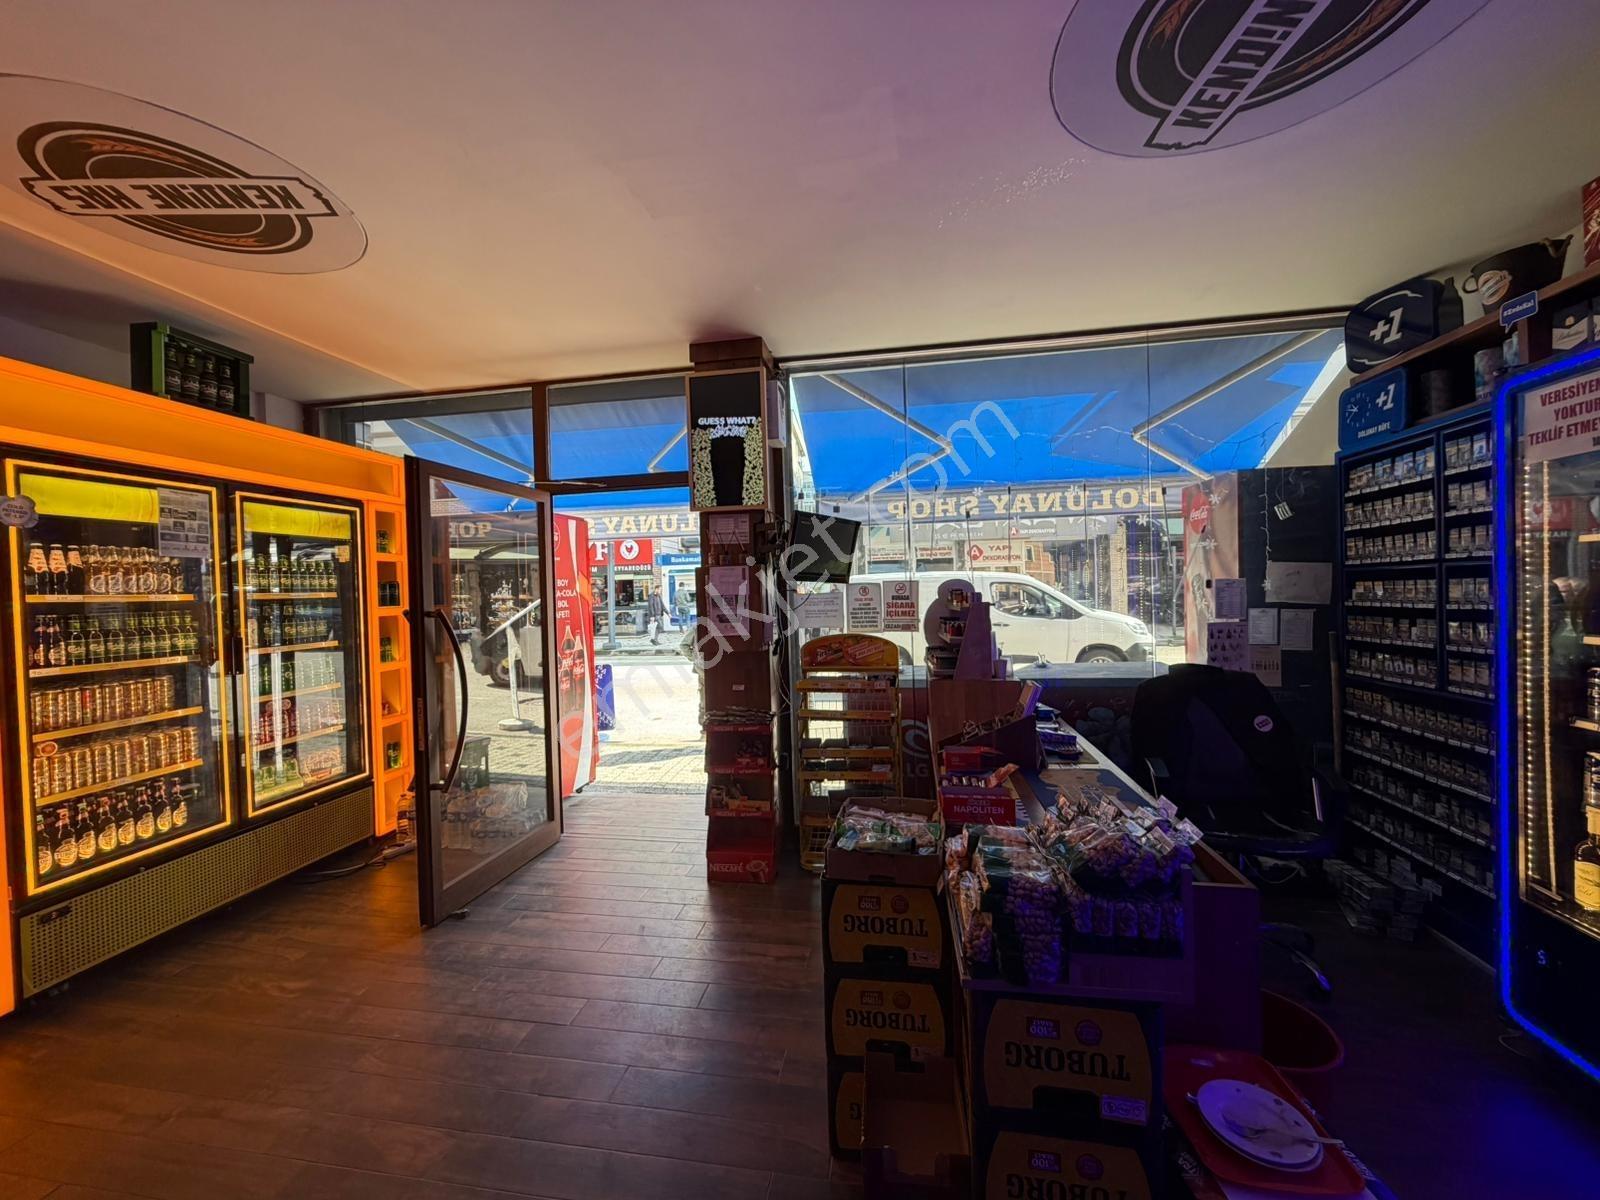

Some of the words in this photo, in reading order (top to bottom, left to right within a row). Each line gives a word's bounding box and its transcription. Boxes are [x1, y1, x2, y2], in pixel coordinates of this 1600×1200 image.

[48, 184, 144, 210] HAS
[1369, 306, 1404, 345] +1
[1375, 382, 1397, 412] +1
[698, 416, 725, 426] GUESS
[725, 415, 757, 425] WHAT?
[1528, 425, 1564, 446] TEKLİF
[556, 589, 577, 598] A-COLA
[886, 601, 915, 609] SİGARA
[886, 609, 915, 618] İÇİLMEZ
[906, 763, 929, 777] LG
[709, 861, 745, 873] NESCAFÉ
[843, 914, 929, 938] TUBORG
[845, 1008, 930, 1033] TUBORG
[1004, 1041, 1131, 1082] TUBORG
